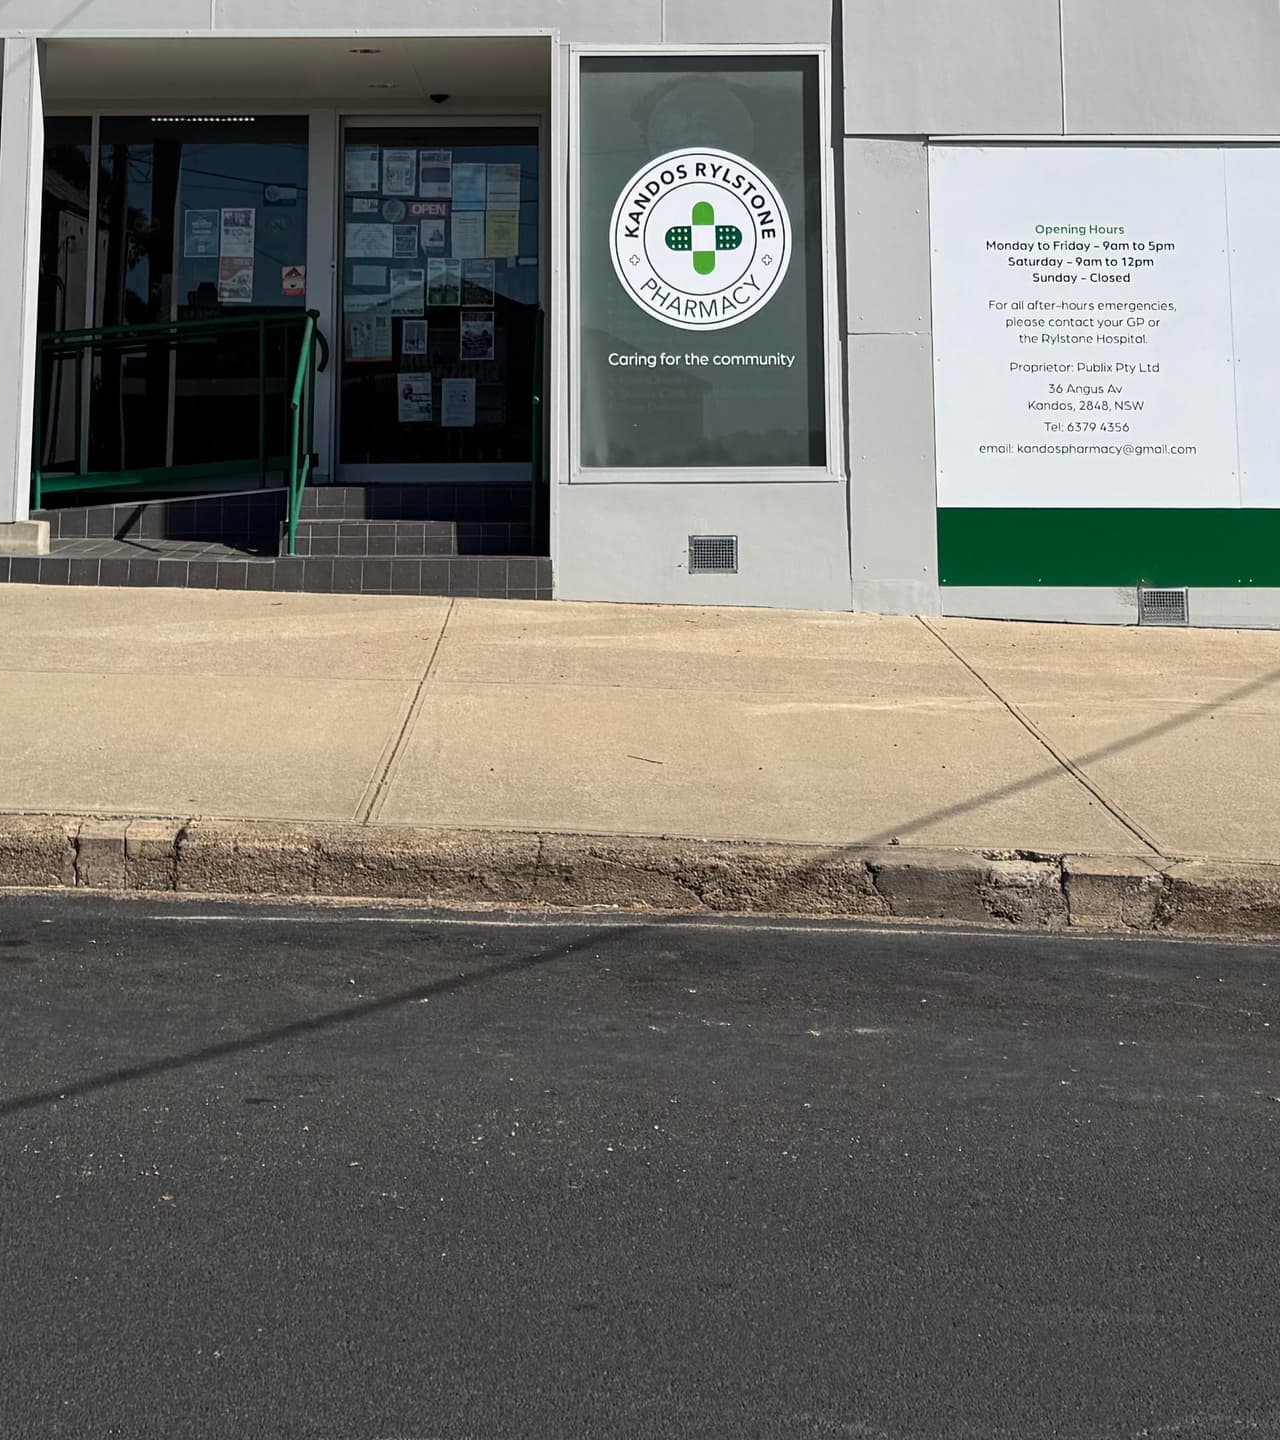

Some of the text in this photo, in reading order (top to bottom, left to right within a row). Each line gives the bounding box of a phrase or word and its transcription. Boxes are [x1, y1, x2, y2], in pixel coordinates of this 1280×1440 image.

[625, 162, 776, 240] KANDOS RYLSTONE
[411, 203, 447, 217] OPEN
[1034, 223, 1125, 236] Opening Hours
[986, 240, 1035, 253] Monday
[1037, 241, 1051, 251] to
[1053, 240, 1091, 253] Friday
[1102, 240, 1130, 251] 9am
[1132, 241, 1146, 251] to
[1148, 240, 1175, 253] 5pm
[1007, 256, 1064, 269] Saturday
[1075, 256, 1103, 267] 9am
[1104, 257, 1118, 267] to
[1121, 256, 1155, 269] 12pm
[1032, 272, 1078, 285] Sunday
[1089, 272, 1131, 283] Closed
[640, 274, 762, 318] PHARMACY
[988, 299, 1177, 313] For all after-hours emergencies,
[1005, 316, 1161, 329] please contact your GP or
[1018, 333, 1148, 346] the Rylstone Hospital.
[608, 352, 795, 368] Caring for the community
[1009, 361, 1160, 375] Proprietor: Publix Pty Ltd
[1048, 383, 1123, 396] 36 Angus Av
[1027, 400, 1145, 412] Kandos, 2848, NSW
[1043, 421, 1130, 433] Tel: 6379 4356
[978, 443, 1197, 456] email: kandospharmacy@gmail.com
